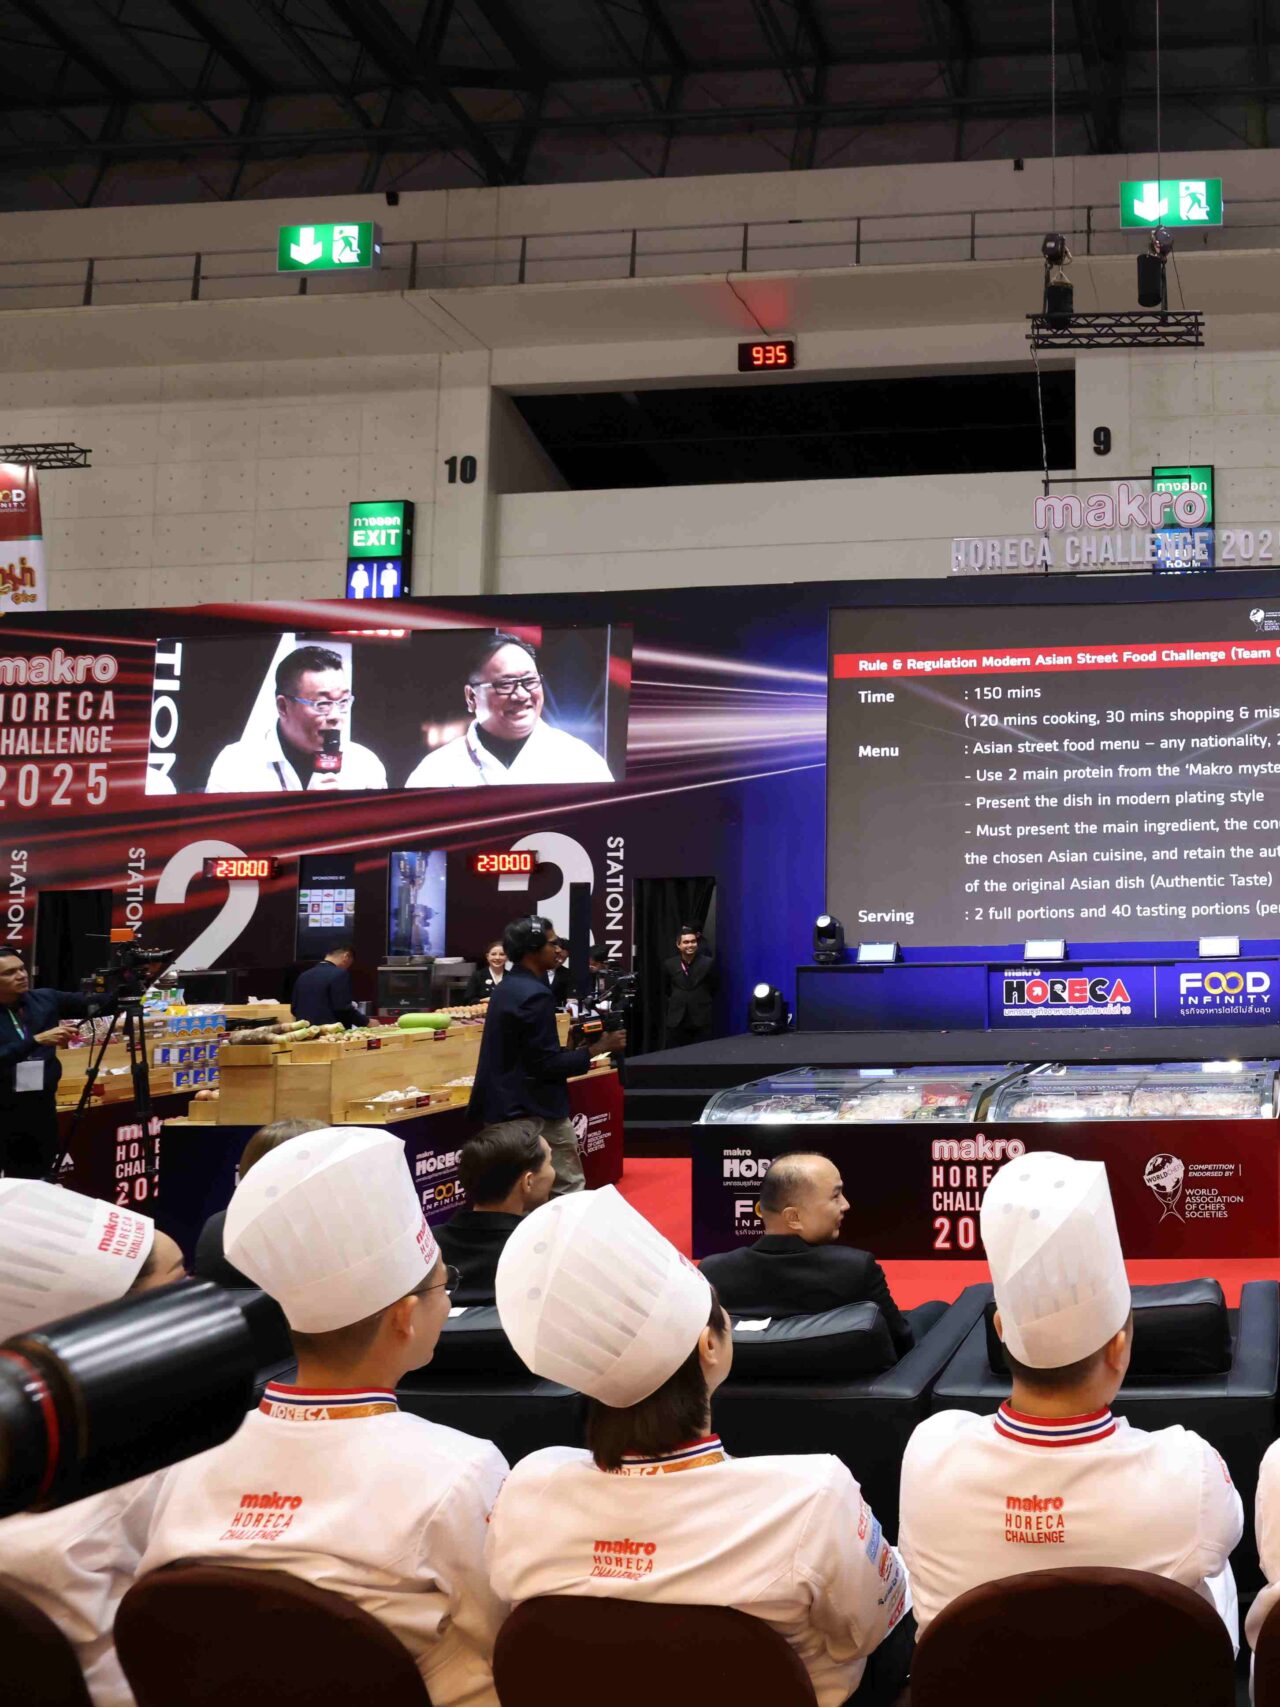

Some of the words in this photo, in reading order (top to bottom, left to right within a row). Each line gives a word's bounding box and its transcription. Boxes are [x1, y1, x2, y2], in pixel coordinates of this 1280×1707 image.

[1093, 426, 1112, 456] 9
[444, 455, 477, 484] 10
[1033, 483, 1207, 530] makro
[353, 528, 400, 547] EXIT
[950, 538, 1053, 572] HORECA
[1064, 531, 1209, 566] CHALLENGE
[0, 648, 118, 686] makro
[858, 659, 888, 672] Rule
[906, 656, 978, 672] Regulation
[981, 655, 1031, 668] Modern
[1034, 653, 1073, 666] Asian
[1076, 652, 1119, 665] Street
[1122, 650, 1157, 663] Food
[1161, 648, 1226, 663] Challenge
[1230, 646, 1272, 661] (Team
[857, 690, 895, 704] Time
[974, 686, 1002, 700] 150
[1007, 685, 1042, 699] mins
[963, 712, 999, 730] (120
[1003, 713, 1039, 727] mins
[1042, 711, 1101, 727] cooking,
[1106, 709, 1125, 723] 30
[1130, 709, 1165, 722] mins
[1169, 707, 1235, 723] shopping
[0, 726, 114, 756] HALLENGE
[972, 741, 1013, 755] Asian
[1017, 739, 1060, 754] street
[1062, 738, 1095, 752] food
[1100, 739, 1140, 751] menu
[1159, 738, 1186, 752] any
[1190, 733, 1272, 749] nationality,
[858, 745, 899, 758] Menu
[976, 769, 1003, 782] Use
[1008, 768, 1017, 781] 2
[1022, 766, 1059, 781] main
[1063, 765, 1114, 782] protein
[1117, 764, 1152, 778] from
[1156, 763, 1181, 777] the
[976, 823, 1012, 837] Must
[1016, 822, 1071, 839] present
[1073, 821, 1098, 835] the
[1102, 820, 1139, 834] main
[1144, 818, 1220, 836] ingredient,
[1223, 817, 1248, 831] the
[964, 851, 988, 865] the
[992, 851, 1043, 864] chosen
[1047, 849, 1088, 863] Asian
[1092, 848, 1147, 863] cuisine,
[1151, 847, 1178, 861] and
[1183, 845, 1226, 860] retain
[1229, 845, 1254, 859] the
[605, 836, 625, 931] STATION
[6, 849, 28, 940] STATION
[858, 908, 915, 925] Serving
[974, 907, 984, 921] 2
[988, 906, 1012, 920] full
[1016, 905, 1075, 923] portions
[1079, 904, 1107, 918] and
[1111, 904, 1132, 918] 40
[1135, 903, 1187, 919] tasting
[1191, 901, 1251, 919] portions
[1004, 967, 1041, 977] makro
[1003, 978, 1131, 1004] HORECA
[1179, 971, 1272, 995] FOOD
[1180, 994, 1271, 1005] INFINITY
[723, 1148, 752, 1157] makro
[931, 1133, 1026, 1161] makro
[932, 1165, 992, 1188] HORE
[1188, 1163, 1235, 1171] COMPETITION
[932, 1190, 982, 1212] CHALL
[1185, 1188, 1218, 1196] WORLD
[1185, 1195, 1244, 1203] ASSOCIATION
[1185, 1203, 1197, 1211] OF
[1198, 1203, 1226, 1211] CHEFS
[1185, 1210, 1228, 1218] SOCIETIES
[98, 1211, 120, 1252] makro
[112, 1215, 133, 1257] HORECA
[239, 1491, 303, 1510] makro
[1006, 1494, 1065, 1513] makro
[231, 1512, 295, 1528] HORECA
[1005, 1513, 1065, 1531] HORECA
[219, 1529, 286, 1541] CHALLENGE
[1005, 1530, 1065, 1544] CHALLENGE
[593, 1538, 657, 1556] makro
[593, 1555, 654, 1573] HORECA
